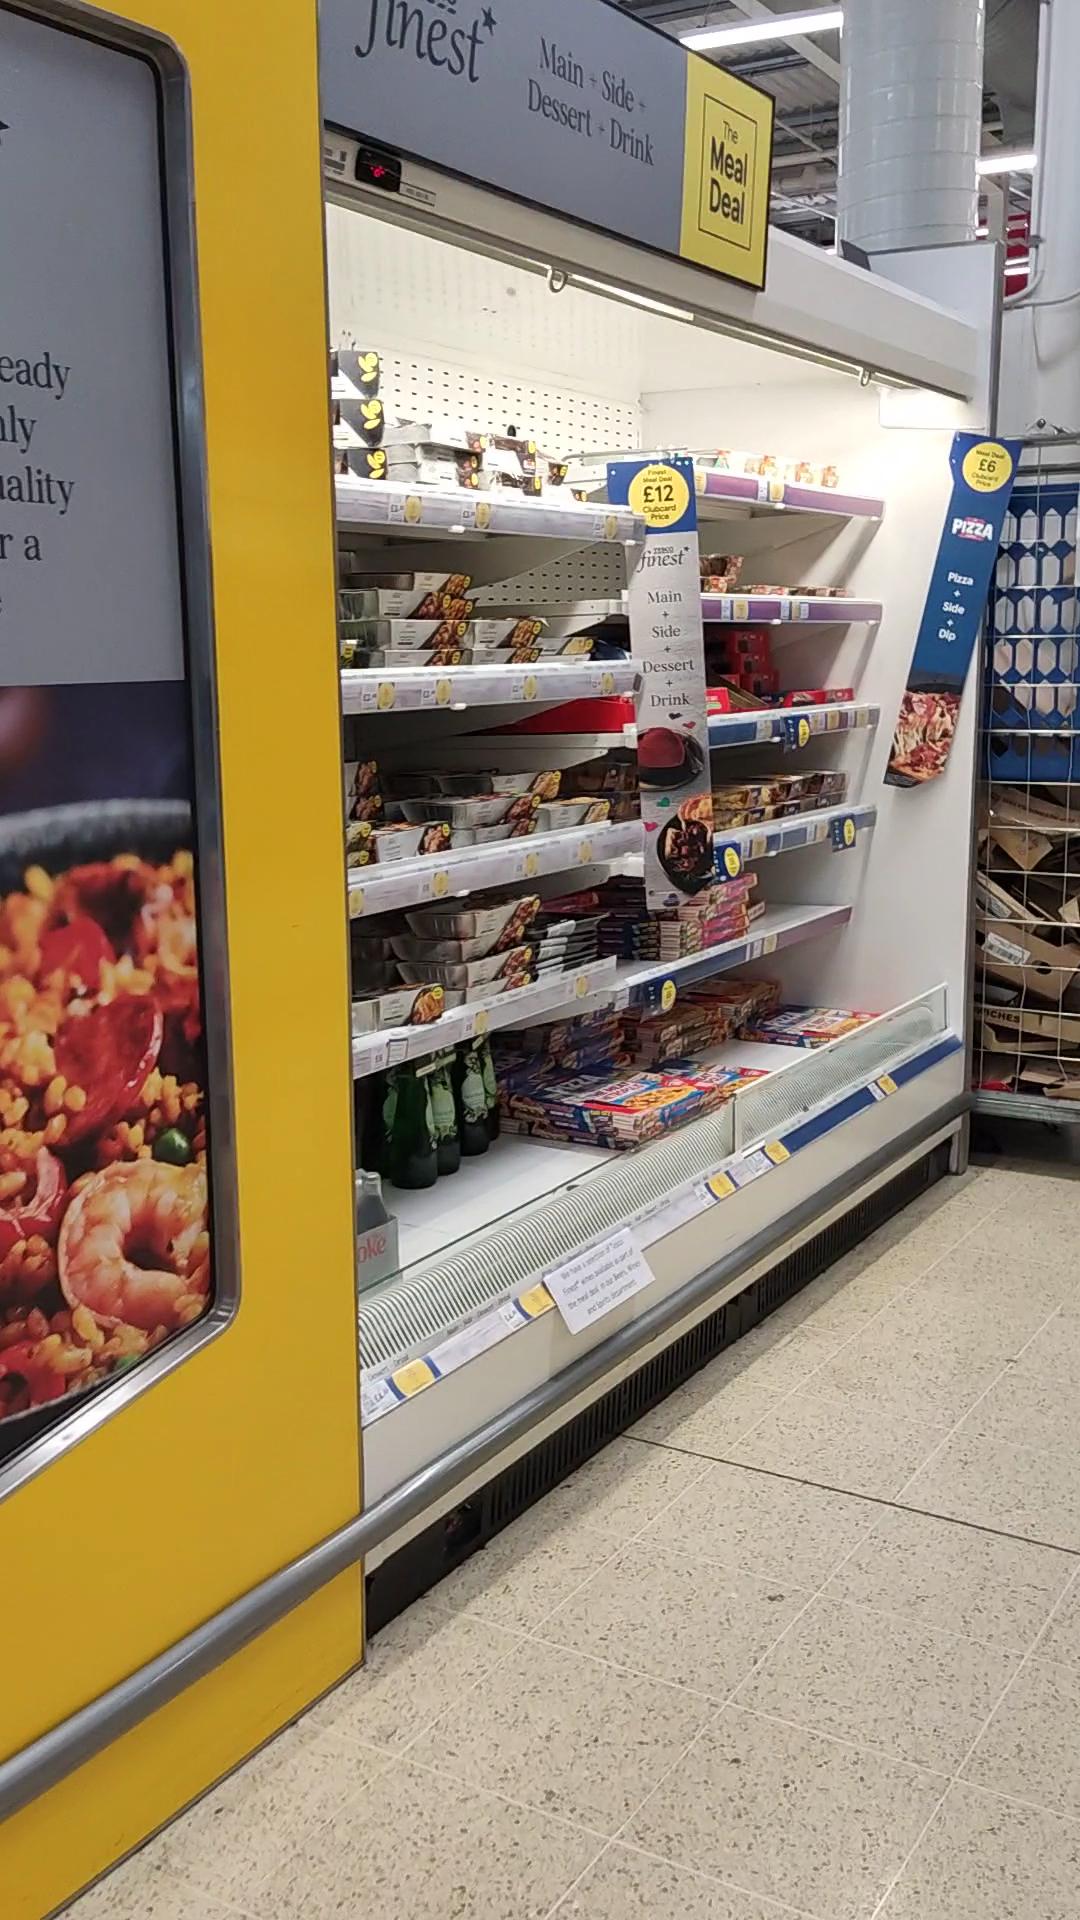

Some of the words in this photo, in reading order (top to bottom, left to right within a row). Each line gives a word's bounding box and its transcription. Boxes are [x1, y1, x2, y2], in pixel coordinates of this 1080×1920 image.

[539, 38, 584, 89] Main
[601, 68, 635, 113] Side
[528, 79, 592, 137] Dessert
[609, 118, 655, 166] Drink
[723, 120, 739, 145] The
[710, 137, 747, 186] Meal
[709, 179, 745, 226] Deal
[978, 458, 997, 473] £6
[643, 484, 674, 503] £12
[642, 504, 677, 513] Clubcard
[650, 513, 670, 521] Price
[952, 518, 993, 541] PIZZA
[24, 534, 42, 561] a
[637, 550, 685, 573] finest
[947, 572, 974, 586] Pizza
[647, 590, 682, 604] Main
[942, 602, 965, 615] Side
[651, 625, 681, 639] Side
[938, 629, 956, 642] Dip
[642, 659, 694, 674] Dessert
[650, 692, 690, 707] Drink
